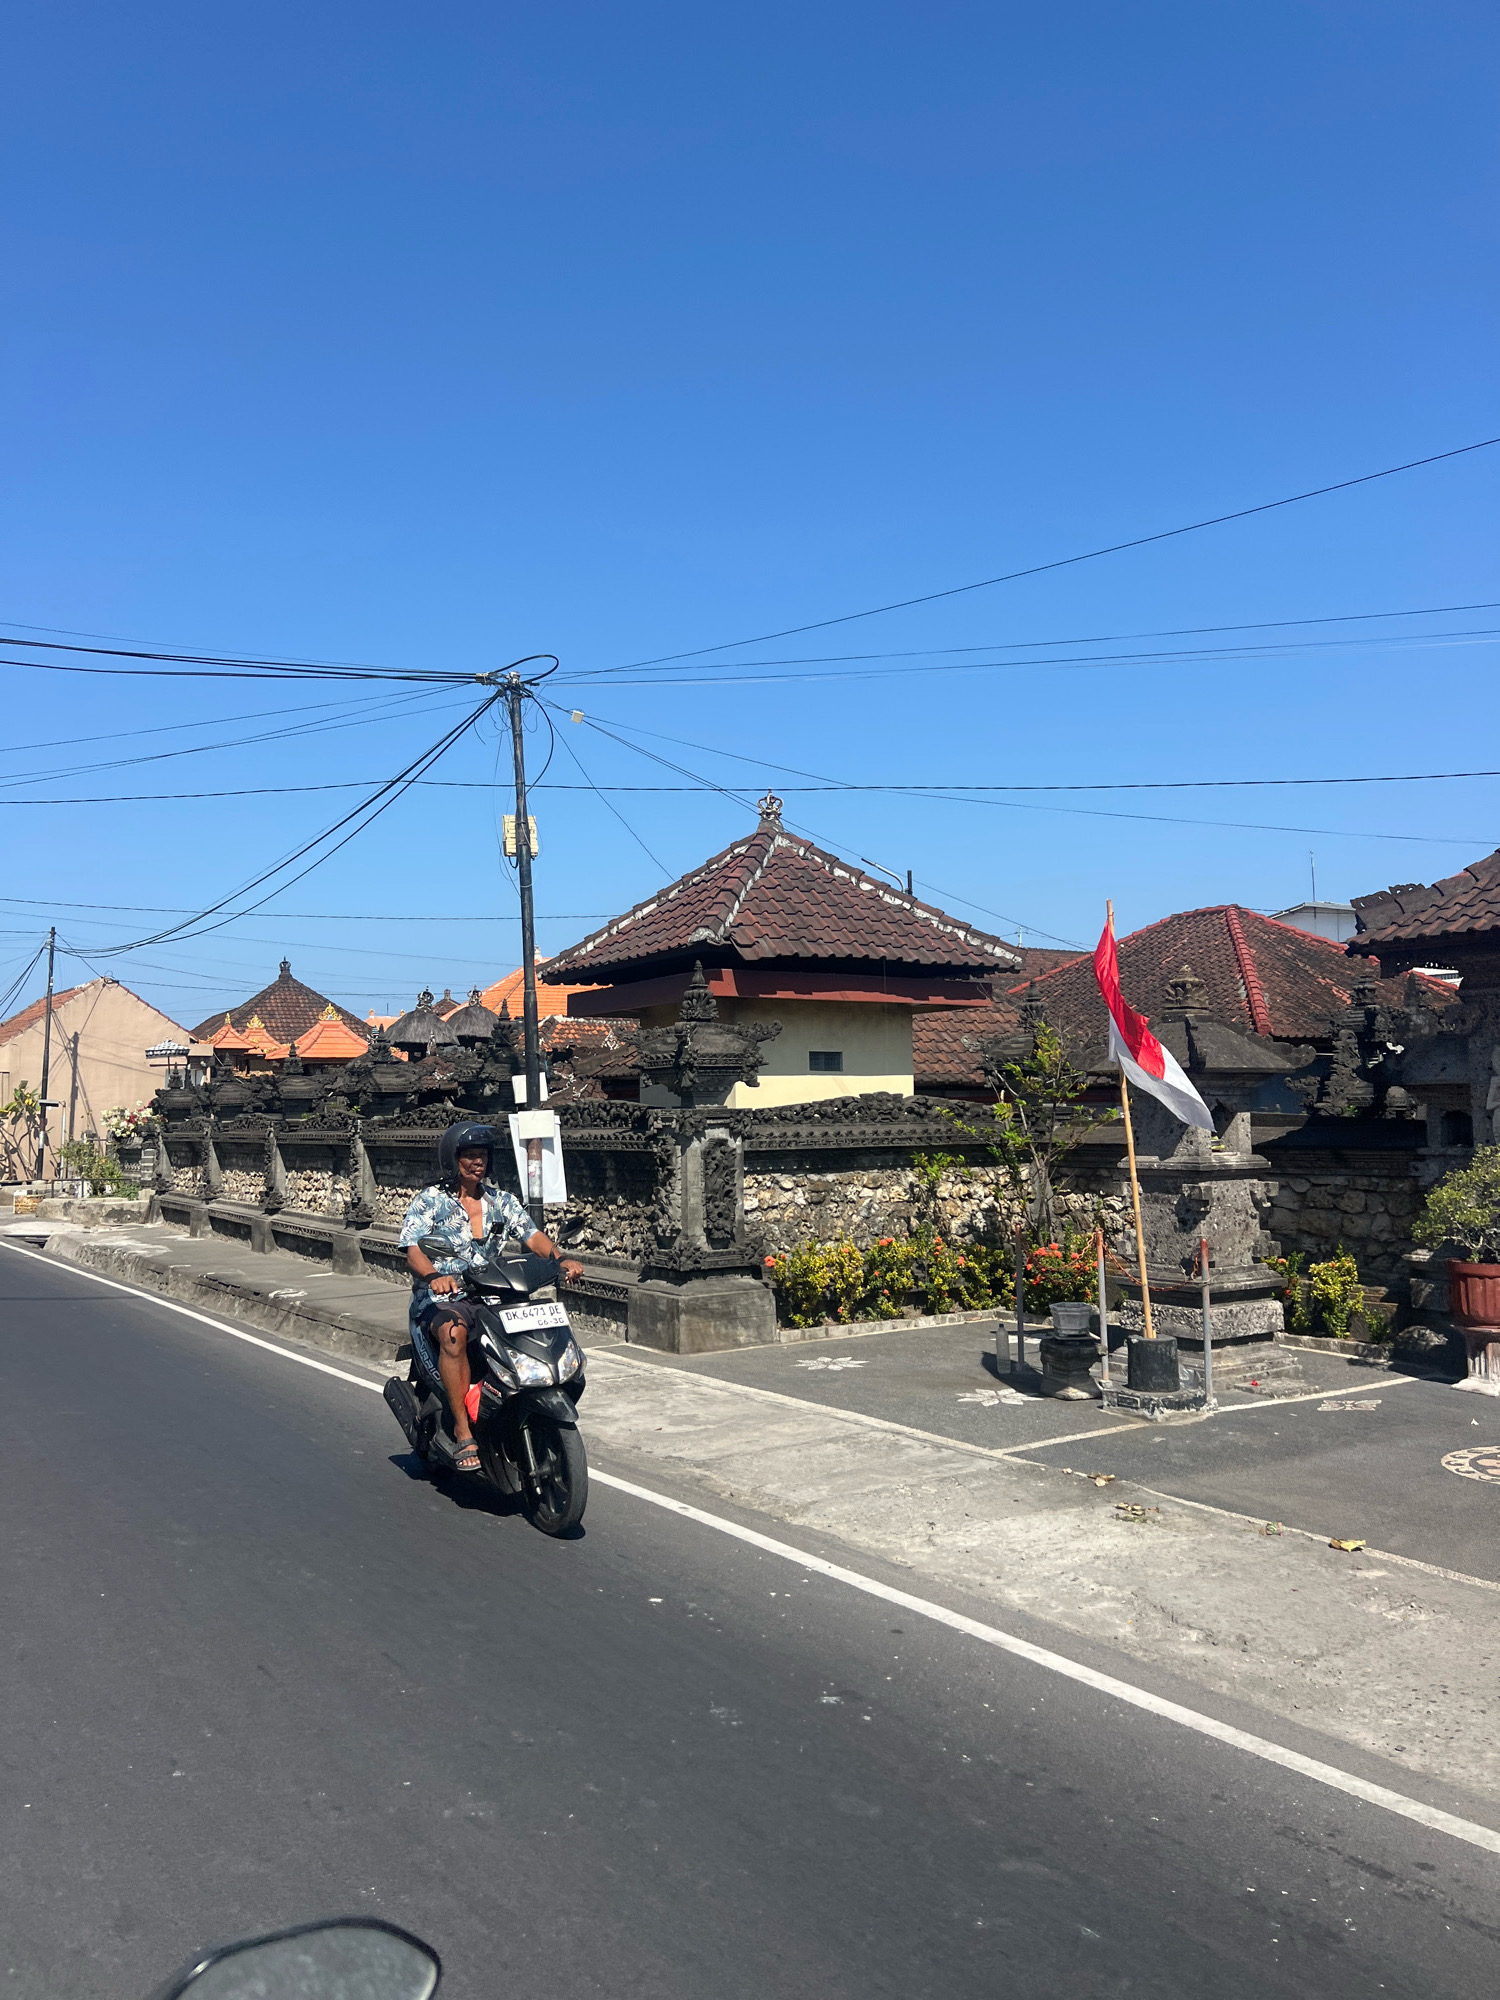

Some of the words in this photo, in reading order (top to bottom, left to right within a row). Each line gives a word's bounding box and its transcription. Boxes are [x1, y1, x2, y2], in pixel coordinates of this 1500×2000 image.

[505, 1311, 520, 1321] DK
[522, 1307, 546, 1318] 6471
[419, 1341, 441, 1381] VARIO
